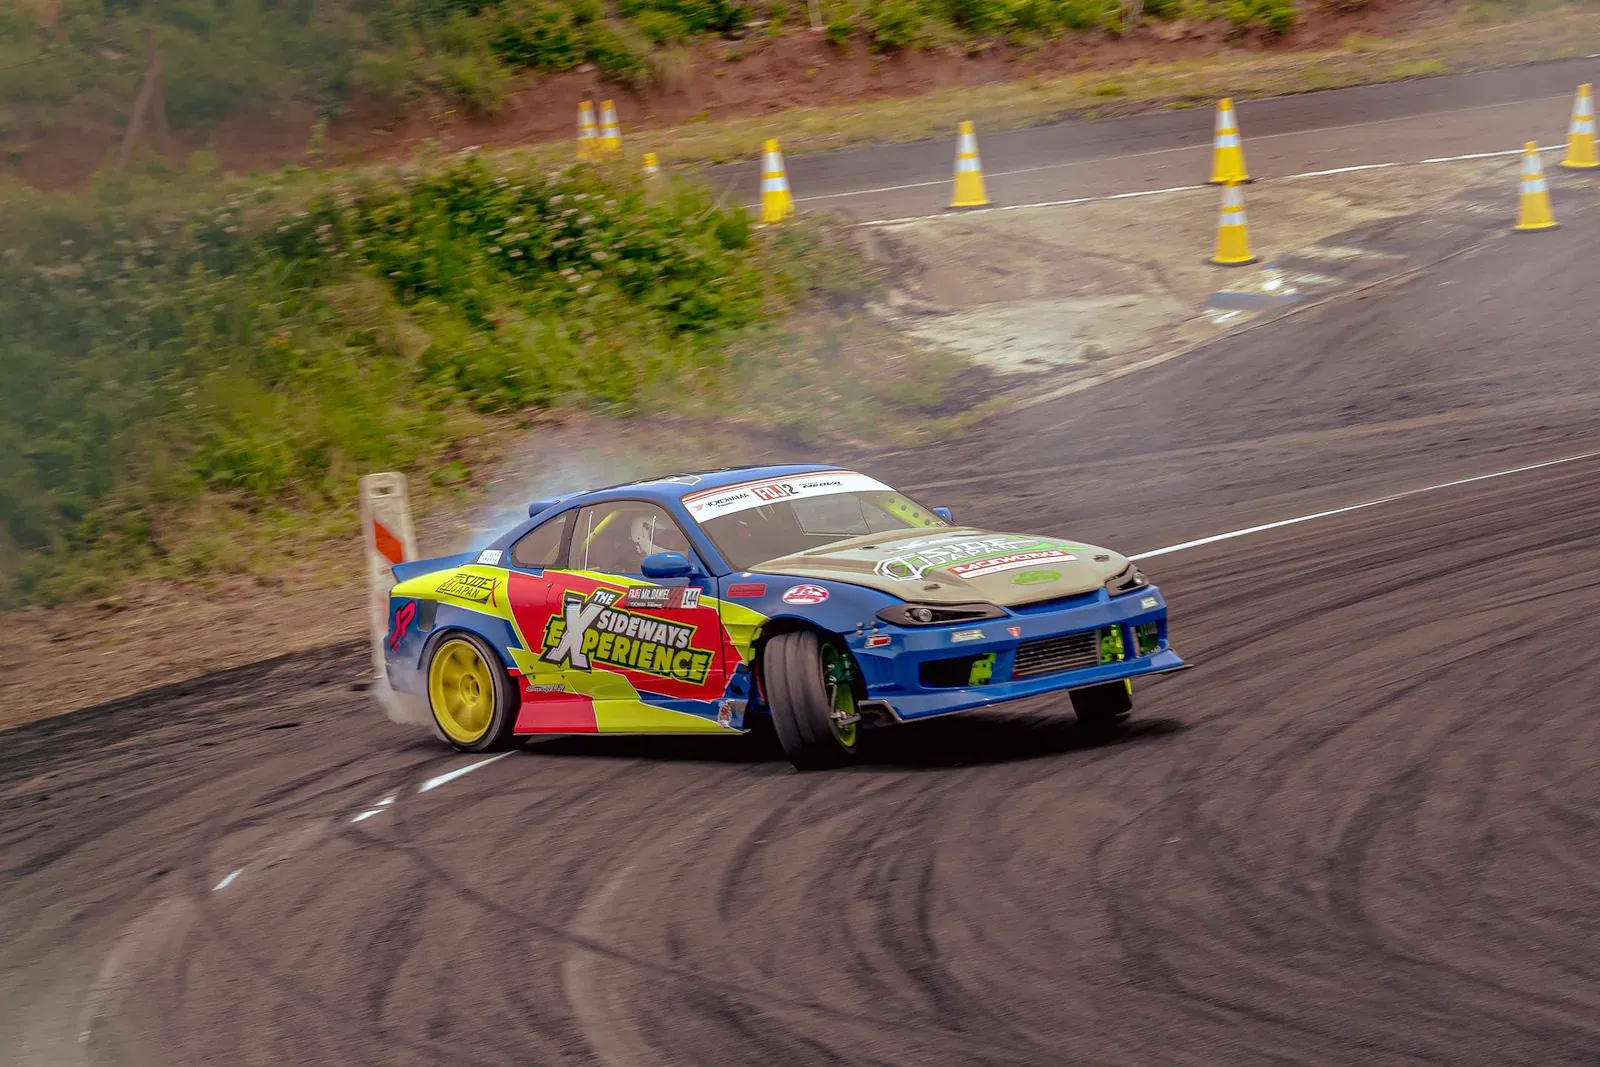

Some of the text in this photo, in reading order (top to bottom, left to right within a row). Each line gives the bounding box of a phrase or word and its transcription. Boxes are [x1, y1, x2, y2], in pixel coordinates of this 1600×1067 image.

[705, 493, 750, 506] YOKOHAMA
[450, 583, 480, 599] JAPAN
[593, 590, 617, 605] THE
[682, 590, 700, 606] 144
[596, 610, 692, 649] SIDEWAYS
[545, 597, 710, 681] EXPERIENCE
